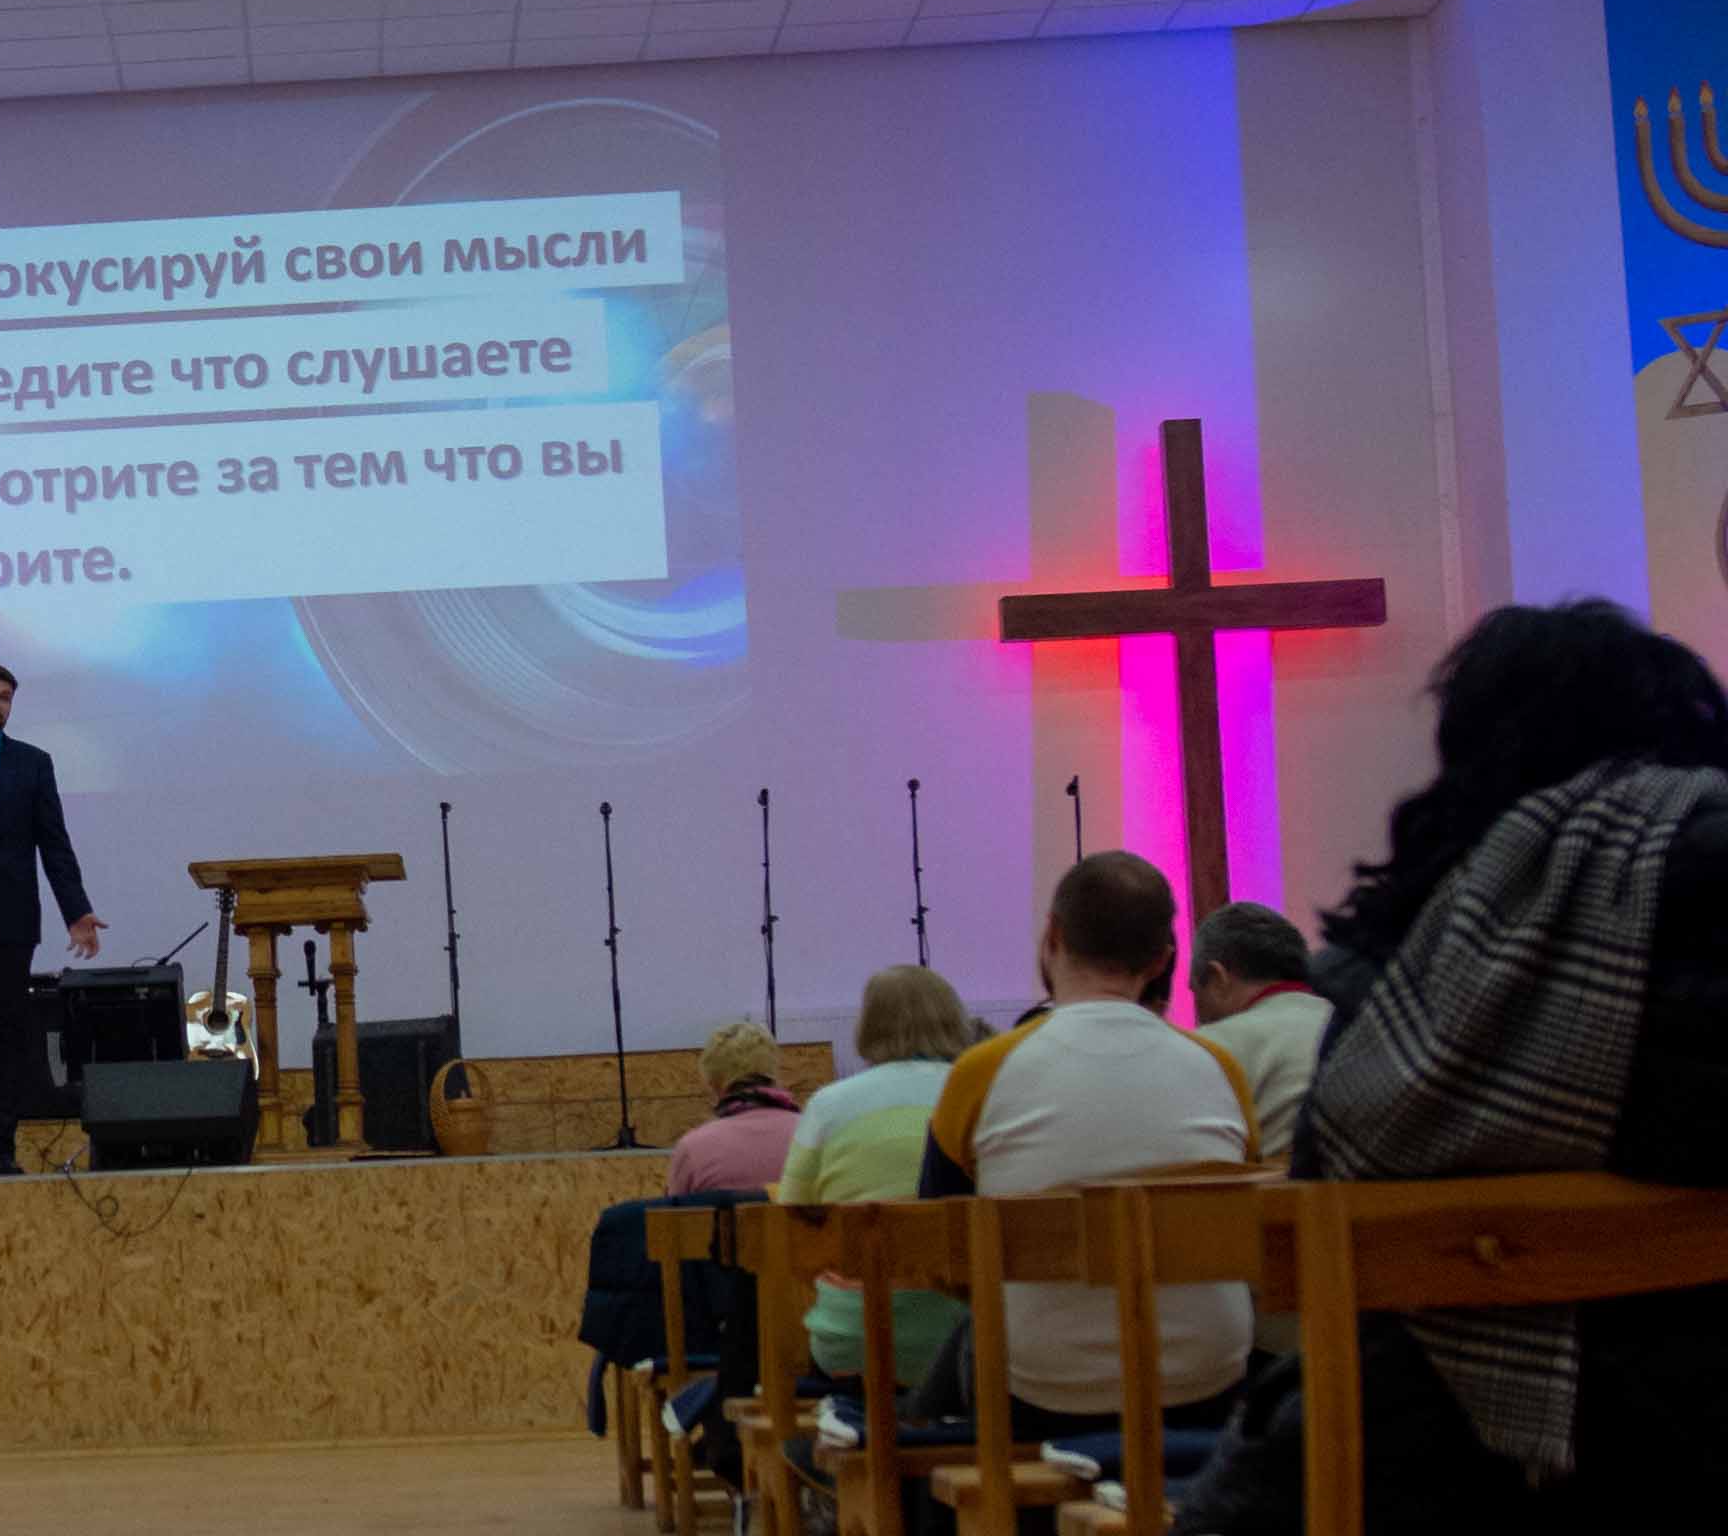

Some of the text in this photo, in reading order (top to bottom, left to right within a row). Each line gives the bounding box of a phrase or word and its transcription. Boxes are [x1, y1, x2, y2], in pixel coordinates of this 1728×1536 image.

[284, 240, 424, 283] свои
[442, 228, 648, 274] мысли
[169, 352, 270, 392] что
[286, 336, 573, 395] слушаете
[216, 455, 280, 495] за
[293, 449, 408, 490] тем
[423, 443, 524, 483] что
[541, 438, 624, 478] вы
